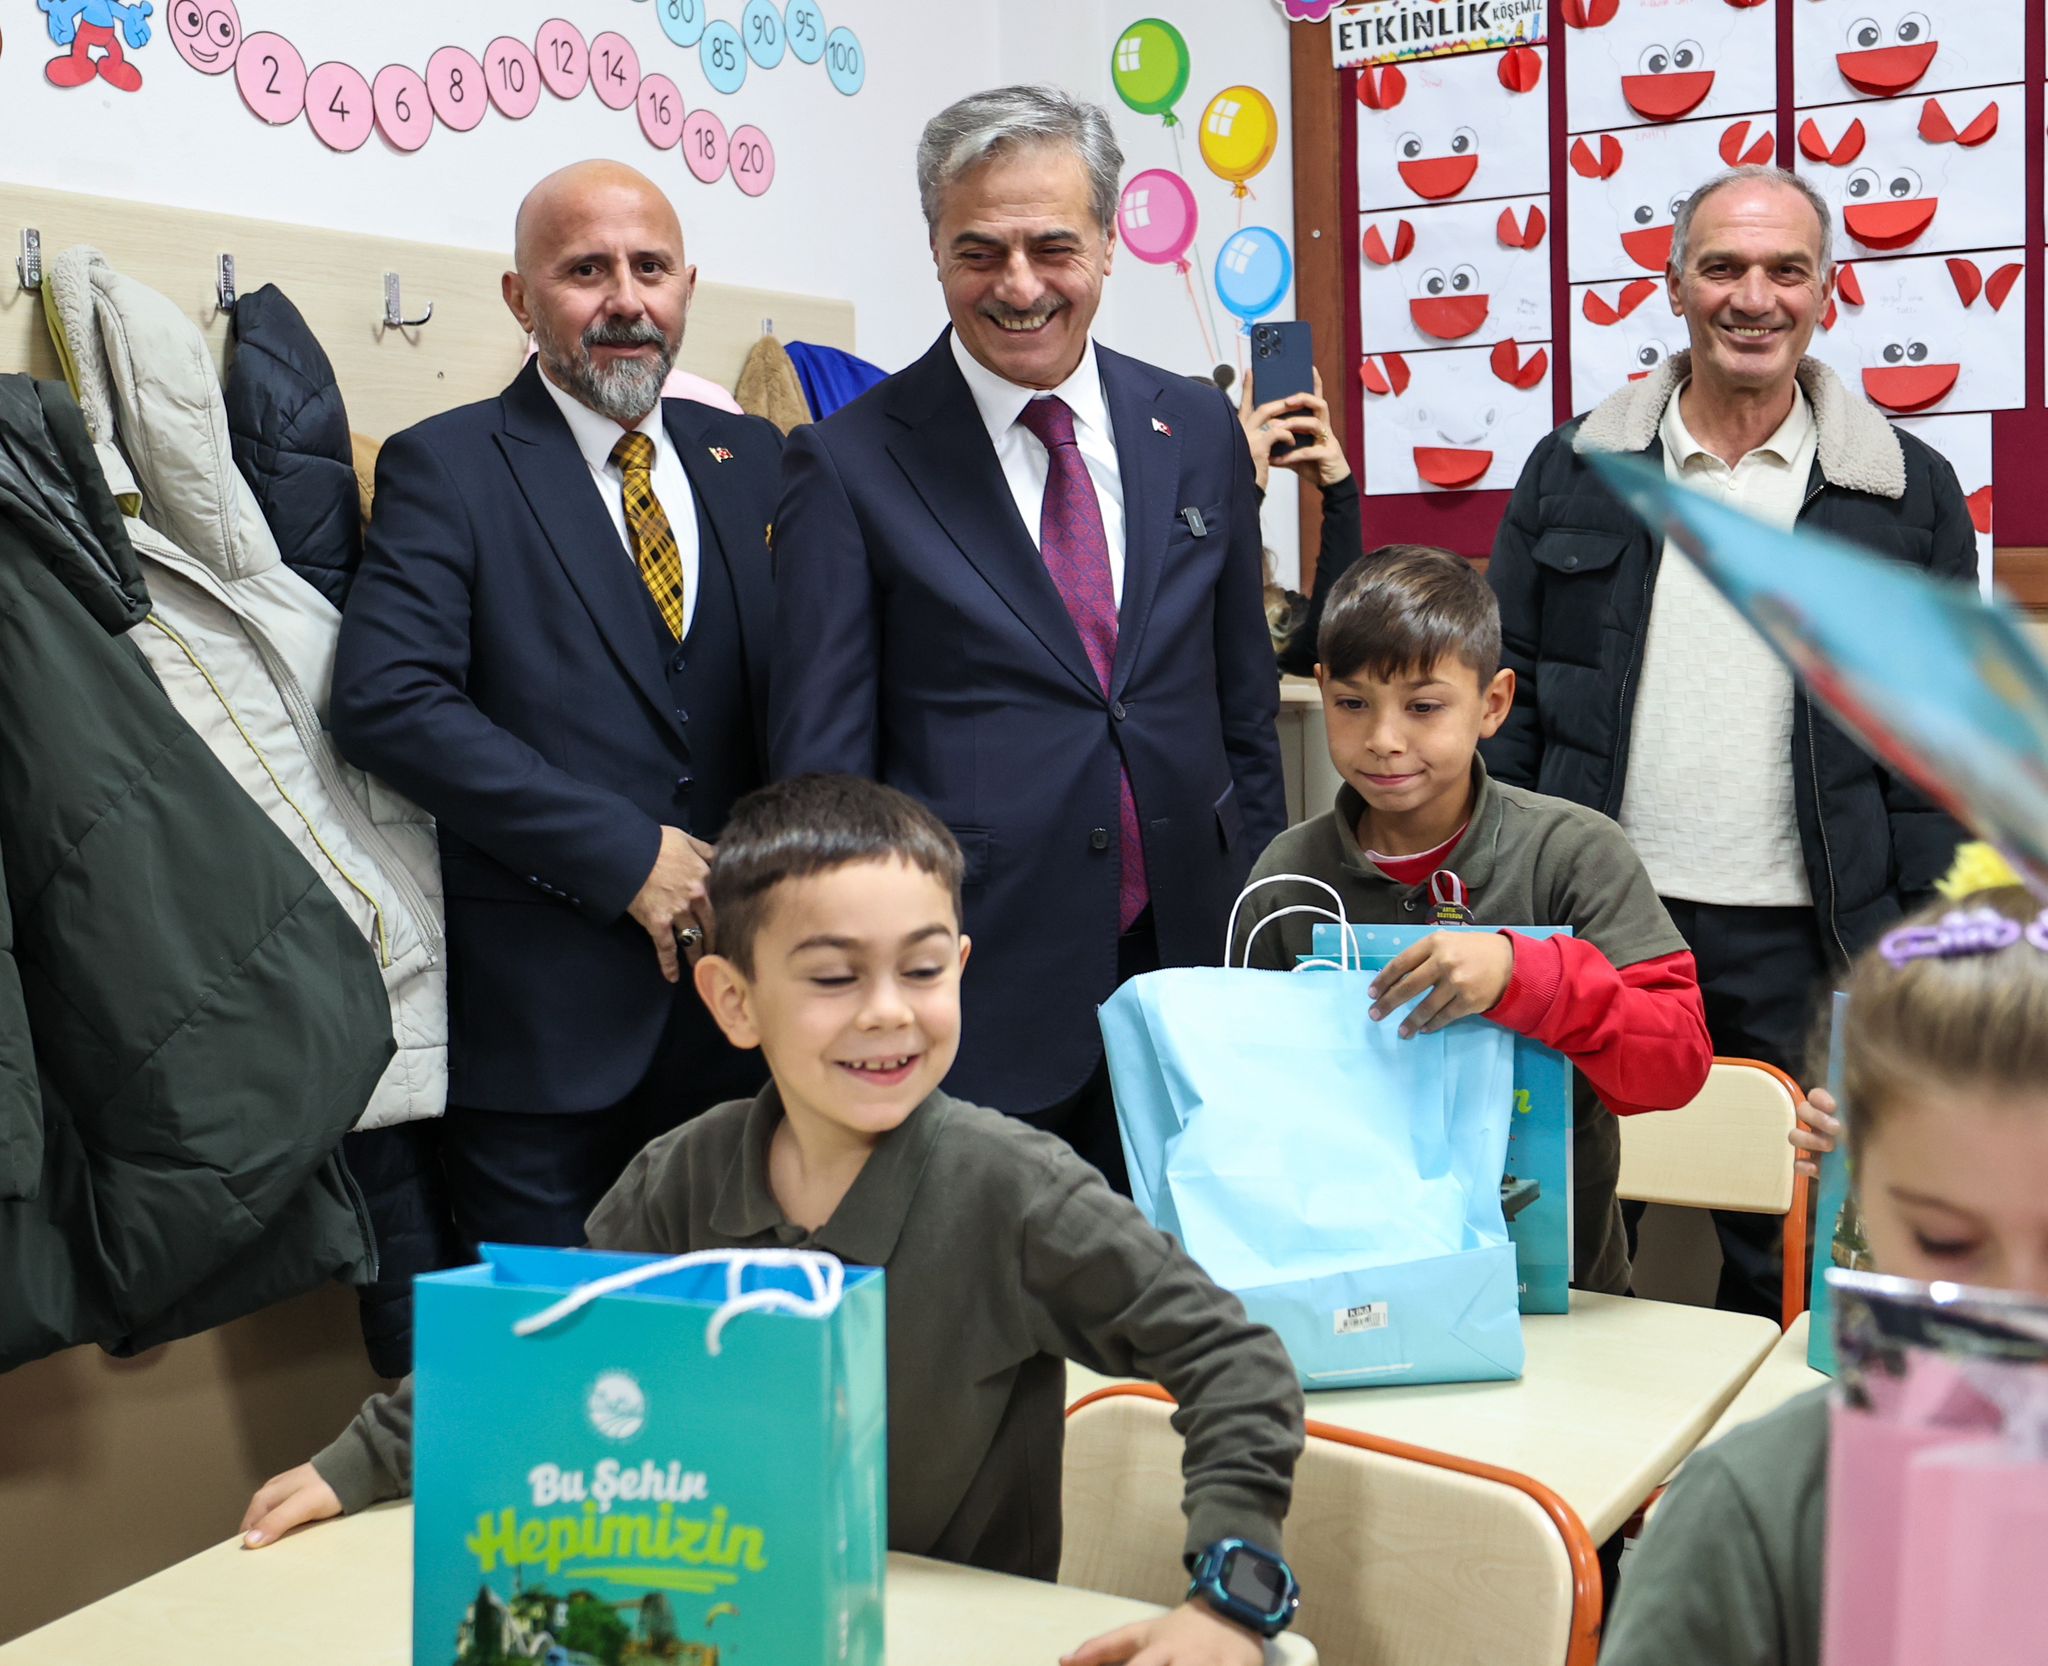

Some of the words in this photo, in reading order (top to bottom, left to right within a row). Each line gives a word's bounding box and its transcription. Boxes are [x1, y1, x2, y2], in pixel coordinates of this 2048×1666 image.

[667, 0, 694, 23] 80
[711, 37, 736, 71] 85
[752, 14, 776, 46] 90
[795, 9, 817, 42] 95
[828, 42, 858, 75] 100
[1338, 0, 1491, 51] ETKİNLİK
[262, 55, 281, 94] 2
[328, 85, 350, 122] 4
[395, 87, 411, 122] 6
[449, 68, 464, 102] 8
[498, 56, 525, 93] 10
[550, 38, 574, 75] 12
[601, 49, 627, 87] 14
[649, 92, 671, 125] 16
[695, 127, 716, 160] 18
[738, 142, 764, 174] 20
[528, 1462, 586, 1506] Bu
[591, 1457, 708, 1513] Şehir
[466, 1499, 767, 1575] Hepimizin
